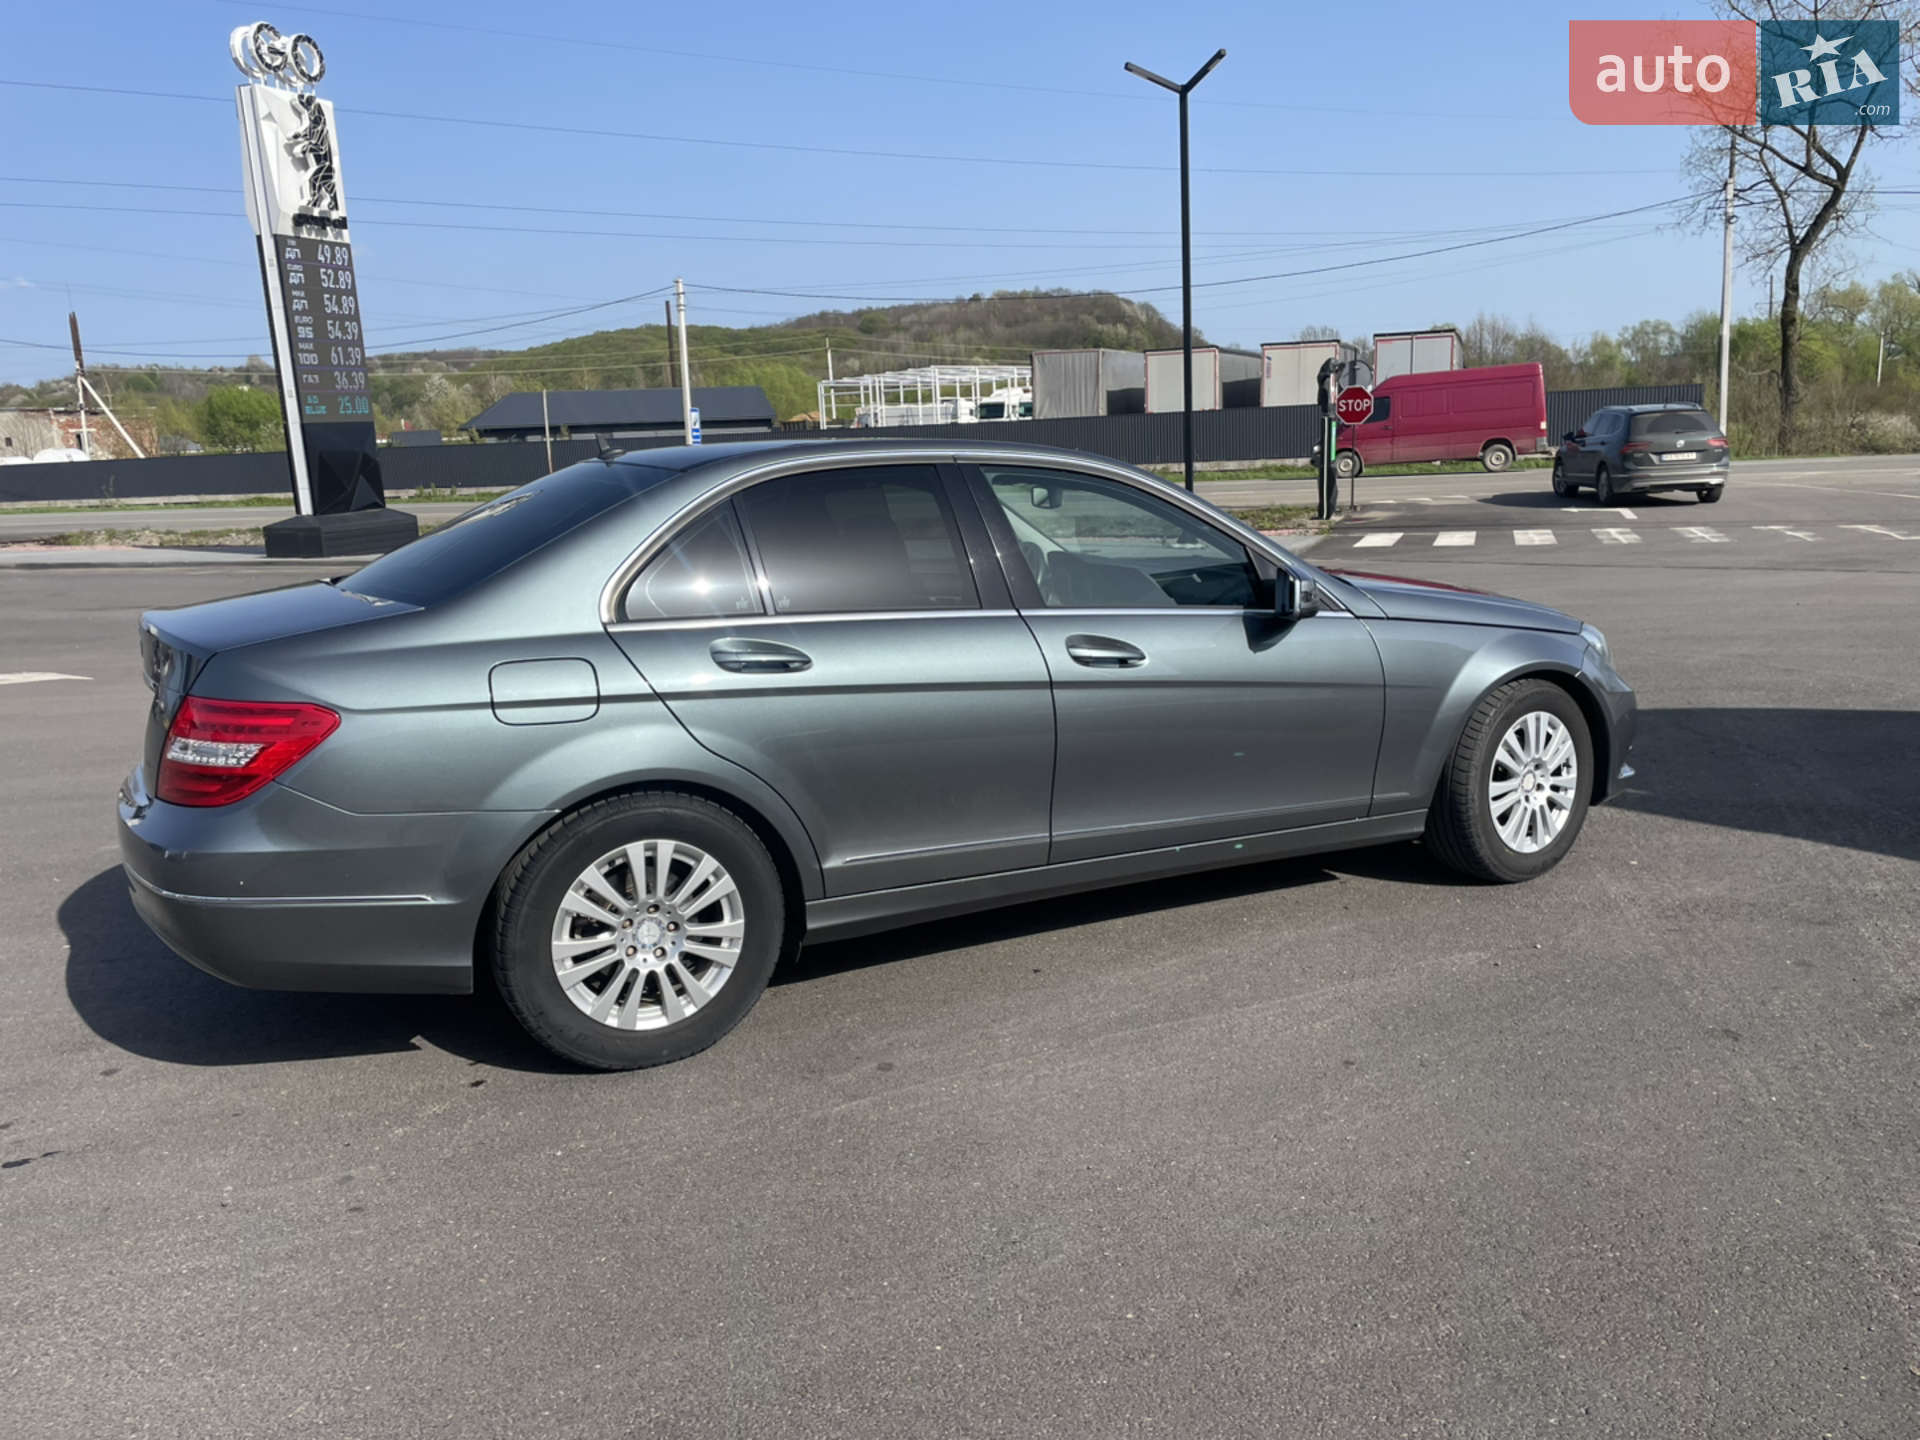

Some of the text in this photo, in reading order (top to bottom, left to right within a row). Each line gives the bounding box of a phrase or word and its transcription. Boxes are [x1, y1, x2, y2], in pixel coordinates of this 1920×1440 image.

[317, 244, 348, 266] 49.89
[320, 268, 352, 290] 52.89
[323, 294, 355, 316] 54.89
[294, 315, 314, 325] EURO
[297, 326, 314, 339] 95
[326, 320, 359, 341] 54.39
[298, 353, 319, 365] 100
[331, 346, 362, 366] 61.39
[302, 374, 320, 384] ГАЗ
[334, 371, 366, 390] 36.39
[1338, 398, 1371, 412] STOP
